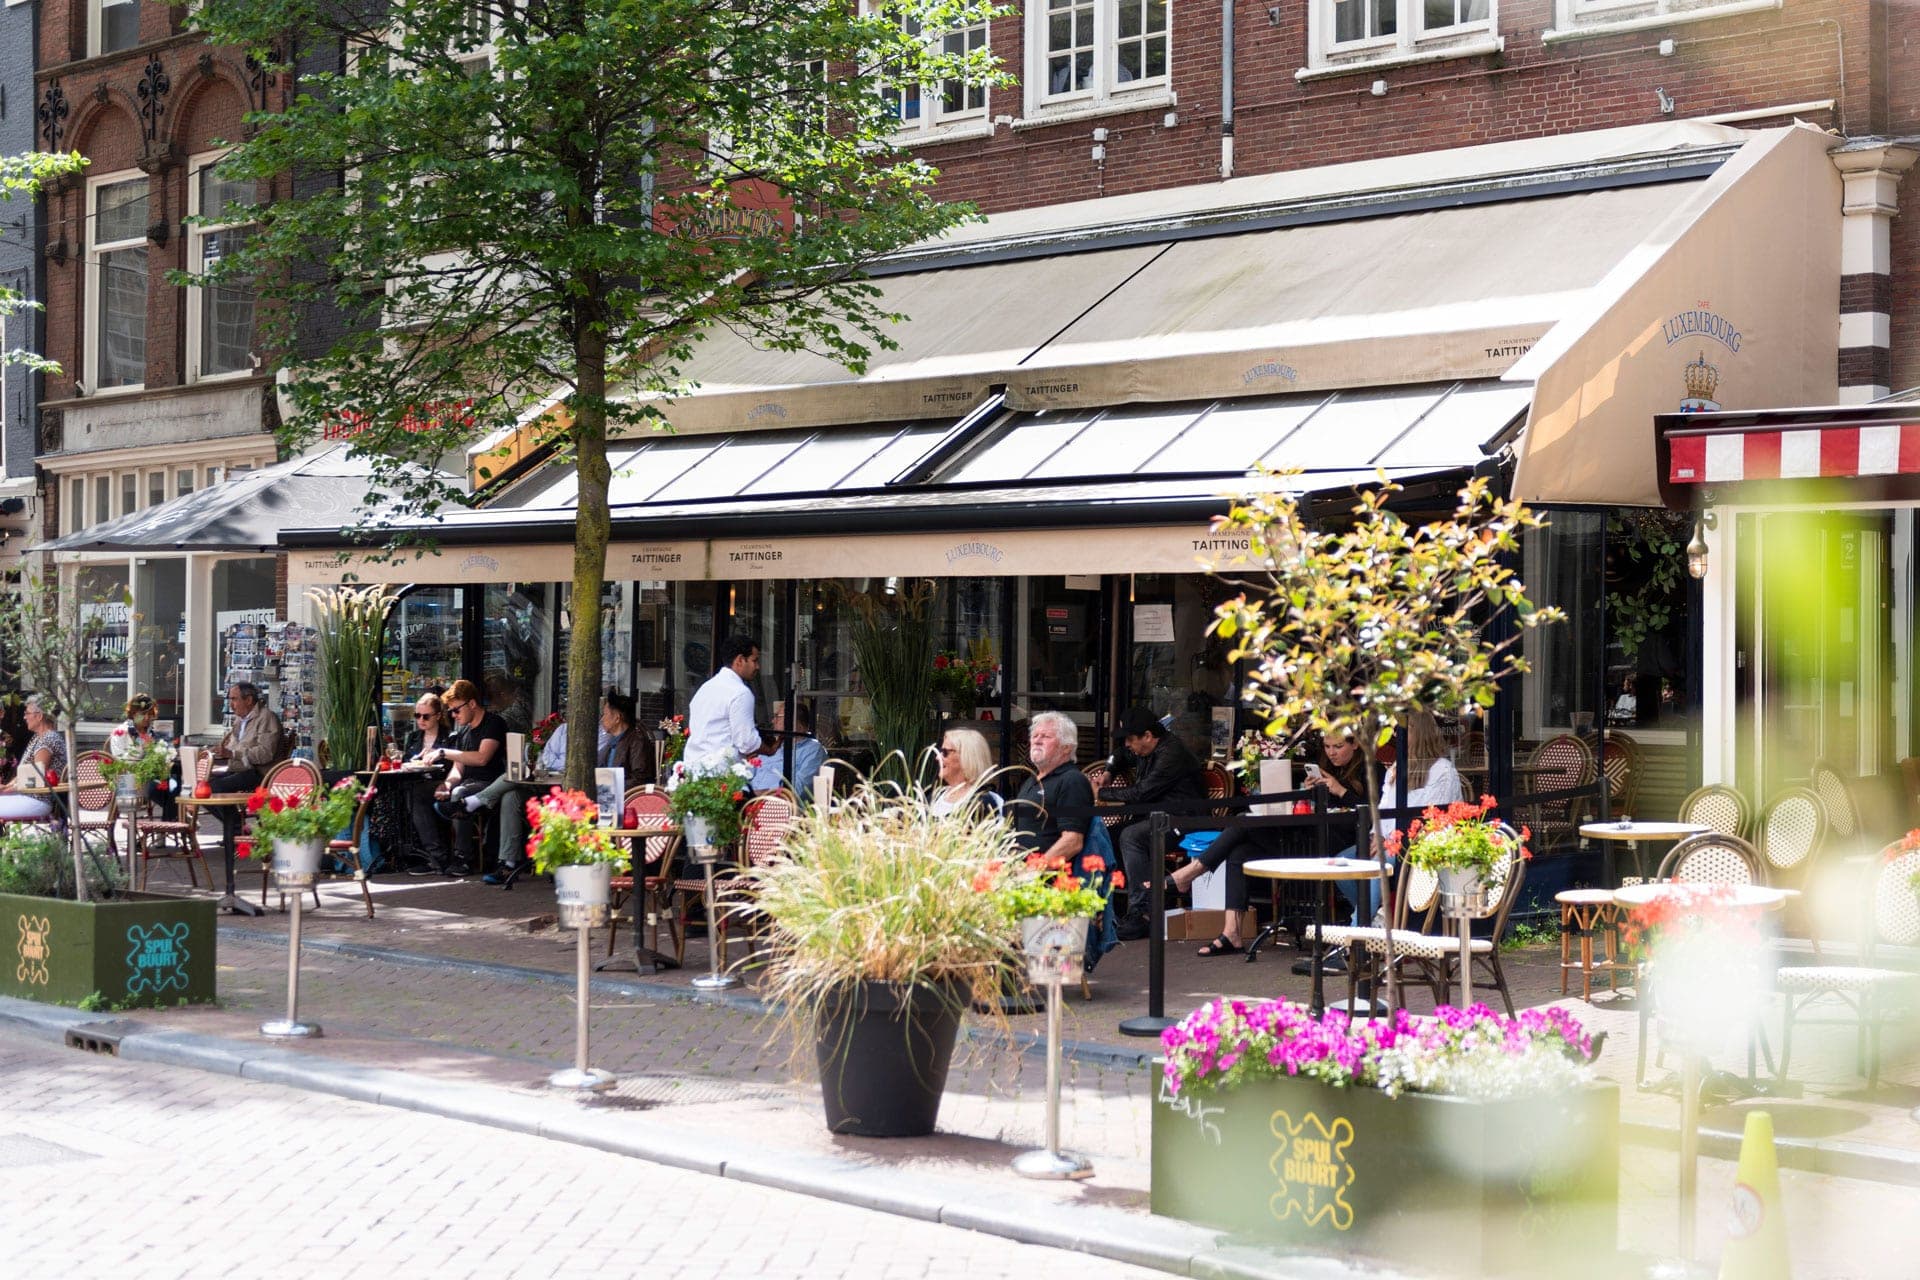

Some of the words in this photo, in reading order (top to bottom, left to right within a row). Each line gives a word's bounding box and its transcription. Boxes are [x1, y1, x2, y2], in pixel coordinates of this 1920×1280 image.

[1663, 311, 1742, 353] LUXEMBOURG
[1243, 363, 1297, 384] LUXEMBOURG
[923, 391, 973, 403] TAITTINGER
[1025, 383, 1079, 395] TAITTINGER
[945, 542, 1004, 562] LUXEMBOURG
[1192, 539, 1249, 551] TAITTING
[631, 554, 682, 563] TAITTINGER
[729, 551, 783, 561] TAITTINGER
[144, 938, 174, 954] SPUI
[137, 951, 179, 968] BUURT
[1293, 1137, 1331, 1163] SPUI
[1284, 1158, 1340, 1188] BUURT
